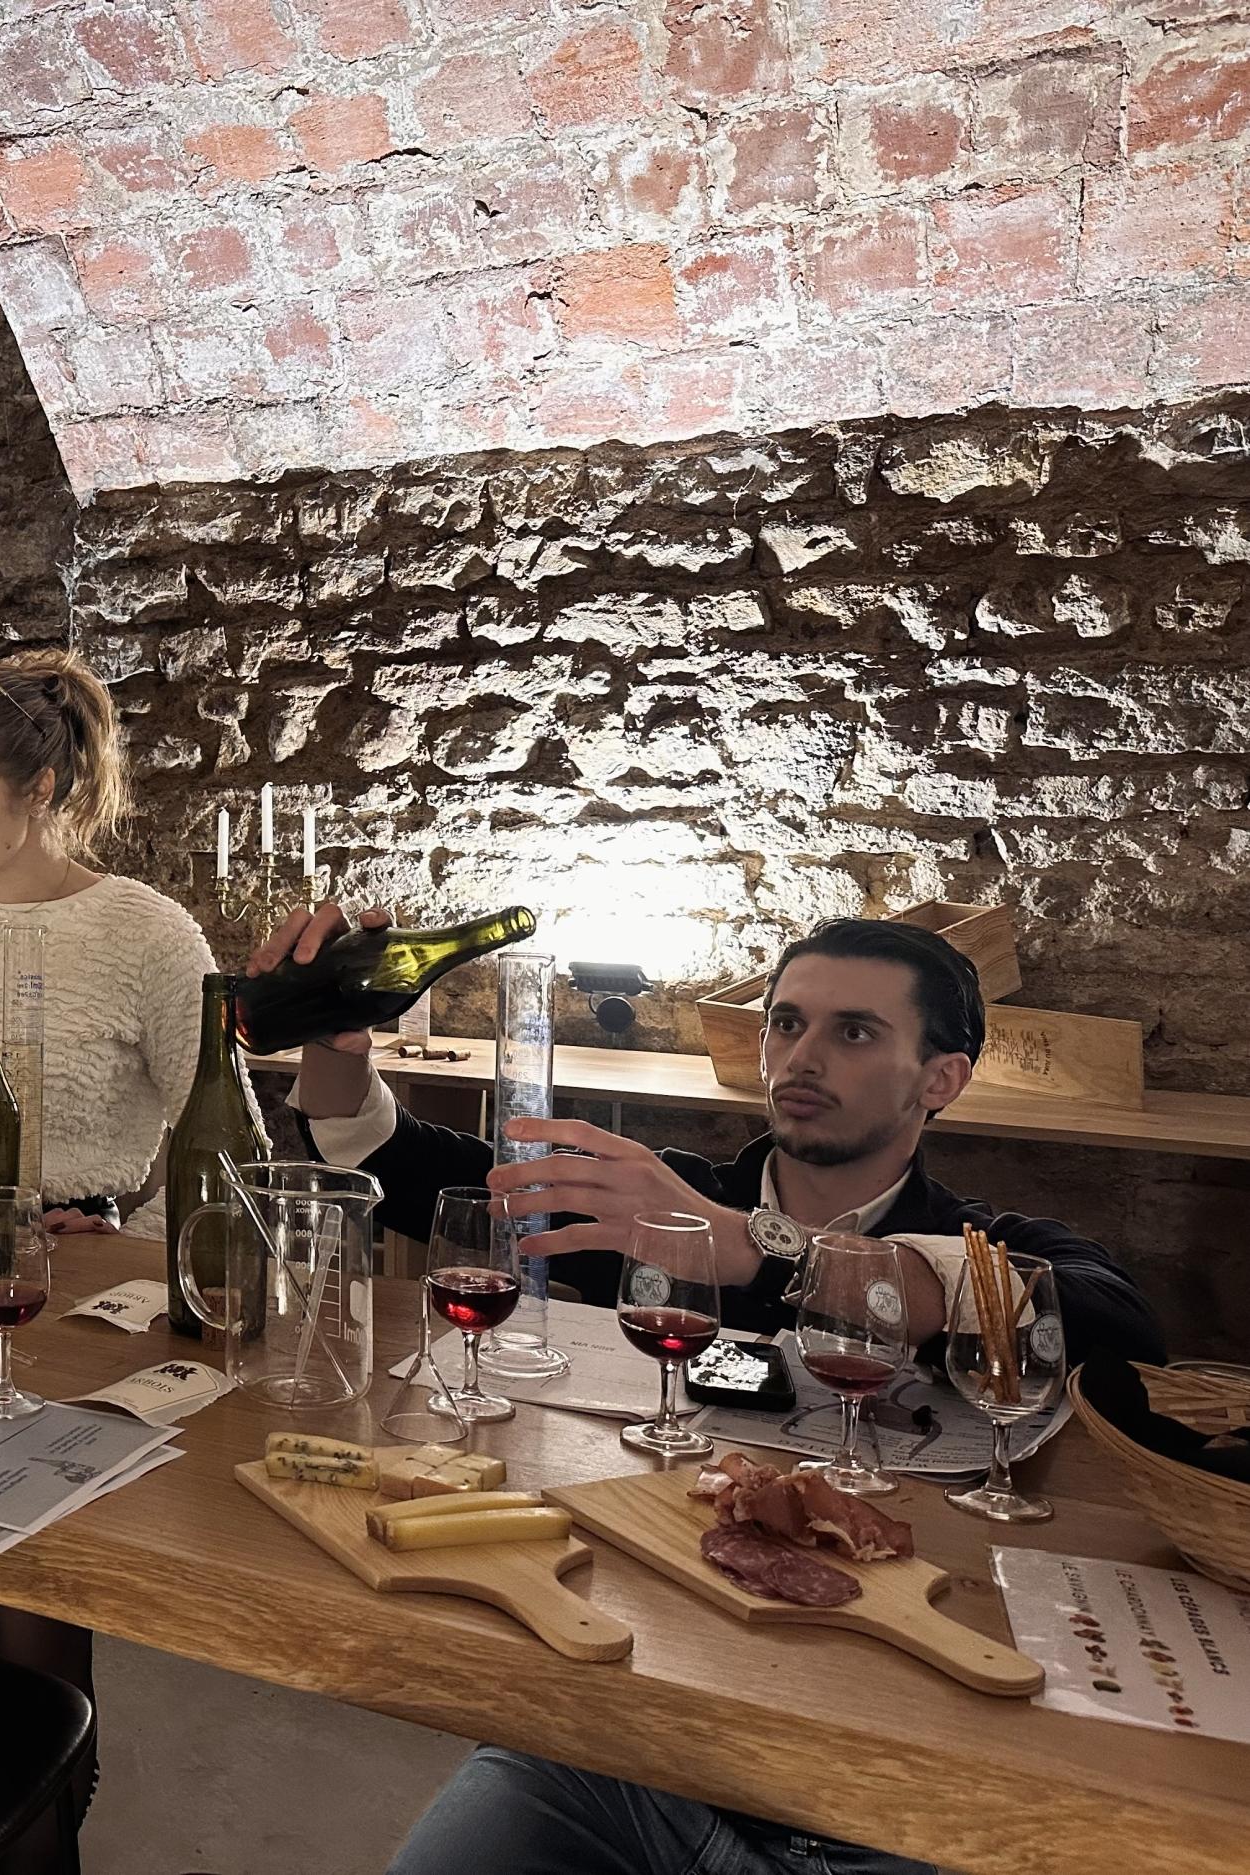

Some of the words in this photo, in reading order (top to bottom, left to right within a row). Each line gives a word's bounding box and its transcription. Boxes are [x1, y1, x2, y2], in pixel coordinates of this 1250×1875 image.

[129, 1377, 175, 1394] ARBOIS
[1170, 1577, 1190, 1595] LES
[1198, 1637, 1231, 1677] BLANCS
